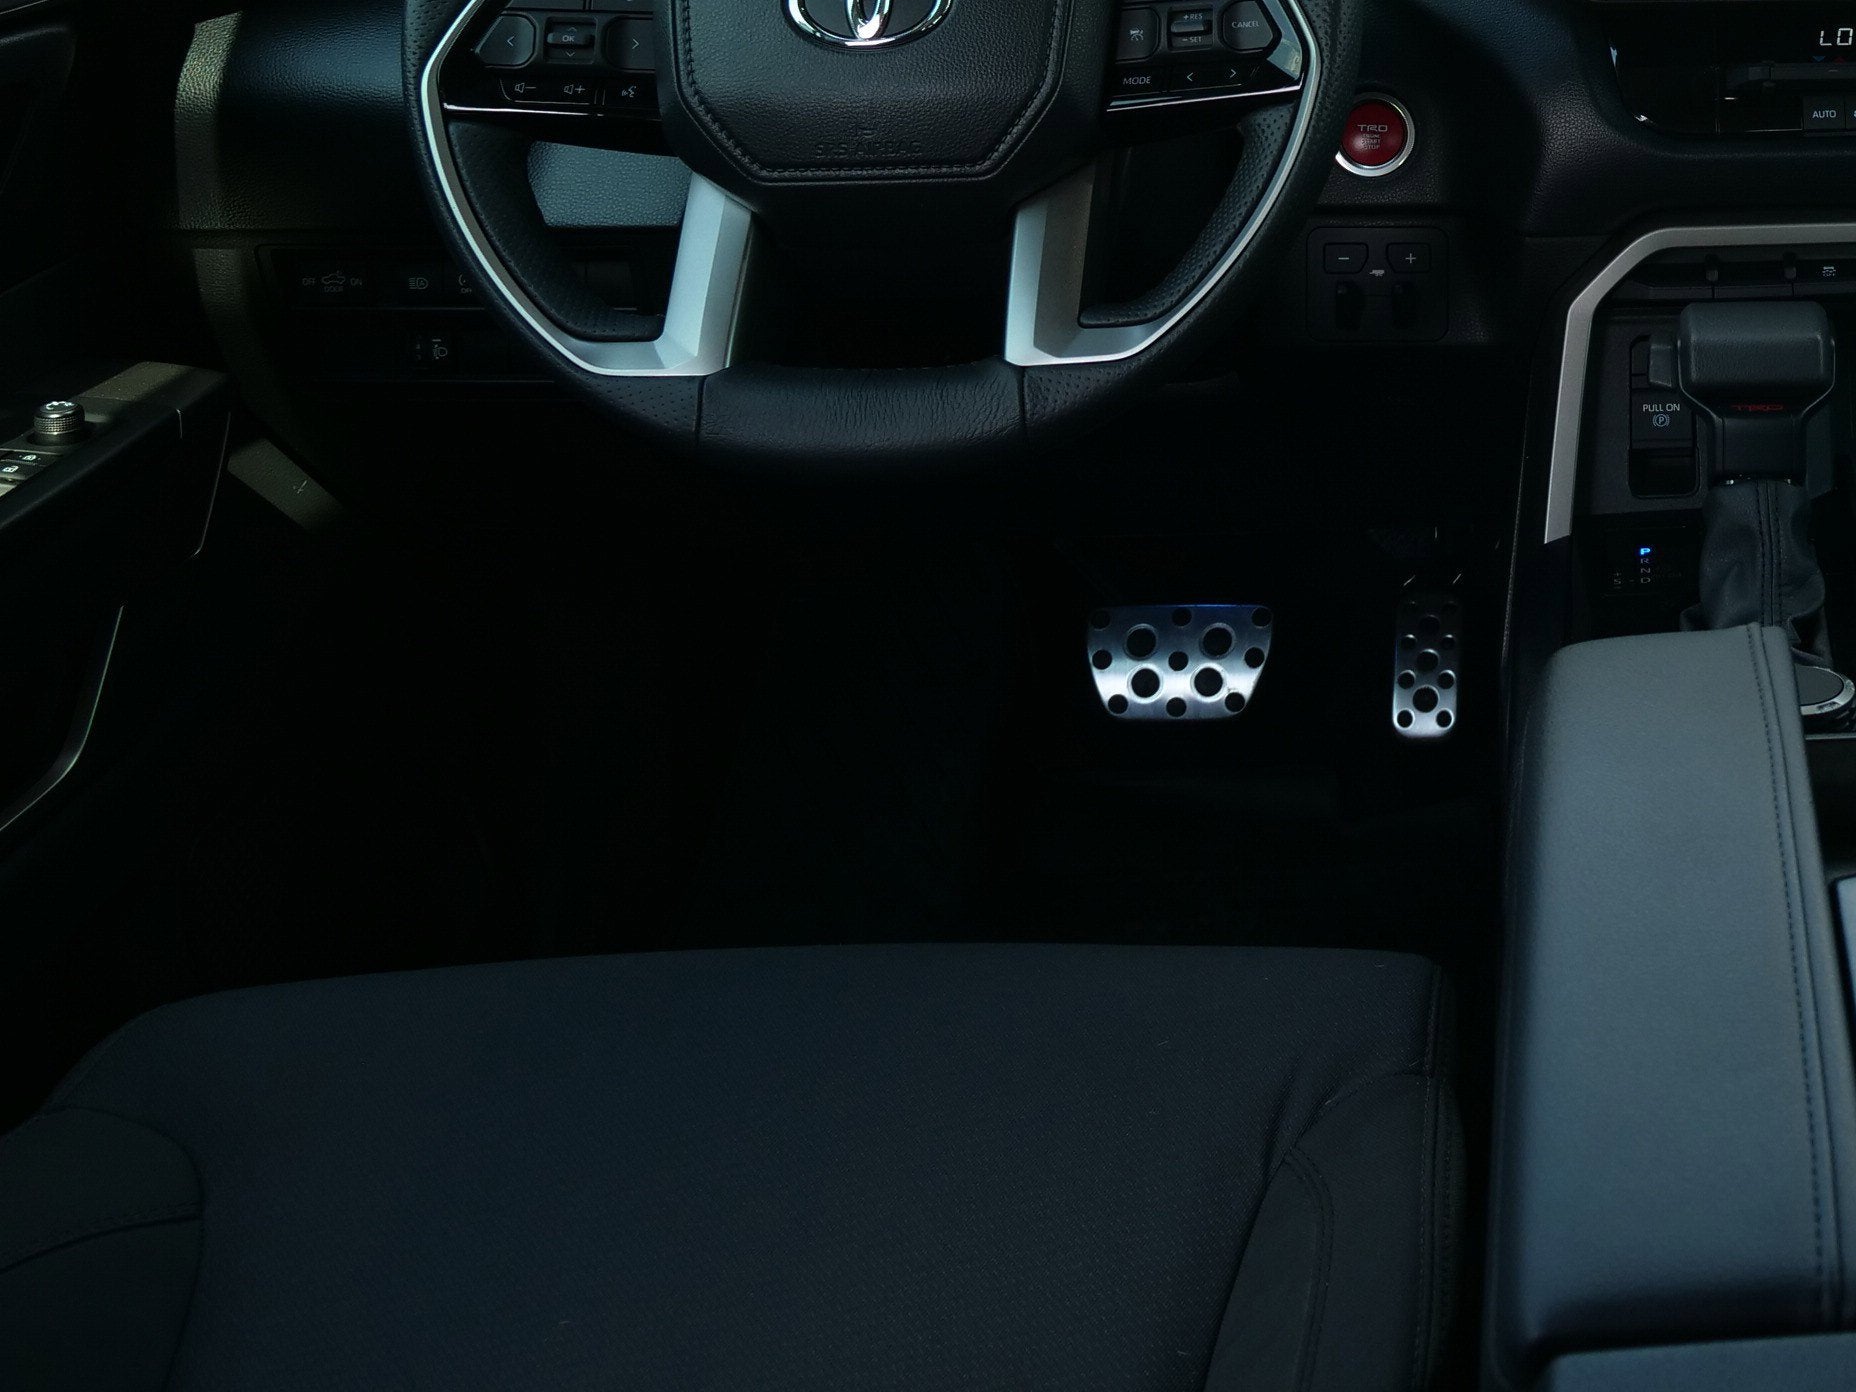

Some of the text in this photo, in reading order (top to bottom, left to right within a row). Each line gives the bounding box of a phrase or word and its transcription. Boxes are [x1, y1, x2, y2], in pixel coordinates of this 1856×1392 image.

[1231, 20, 1260, 29] CANCEL
[1819, 27, 1854, 46] LO
[1122, 75, 1151, 85] MODE
[1812, 109, 1837, 119] AUTO
[1357, 124, 1388, 132] TRD
[1642, 403, 1681, 412] PULL ON
[1640, 547, 1651, 556] P
